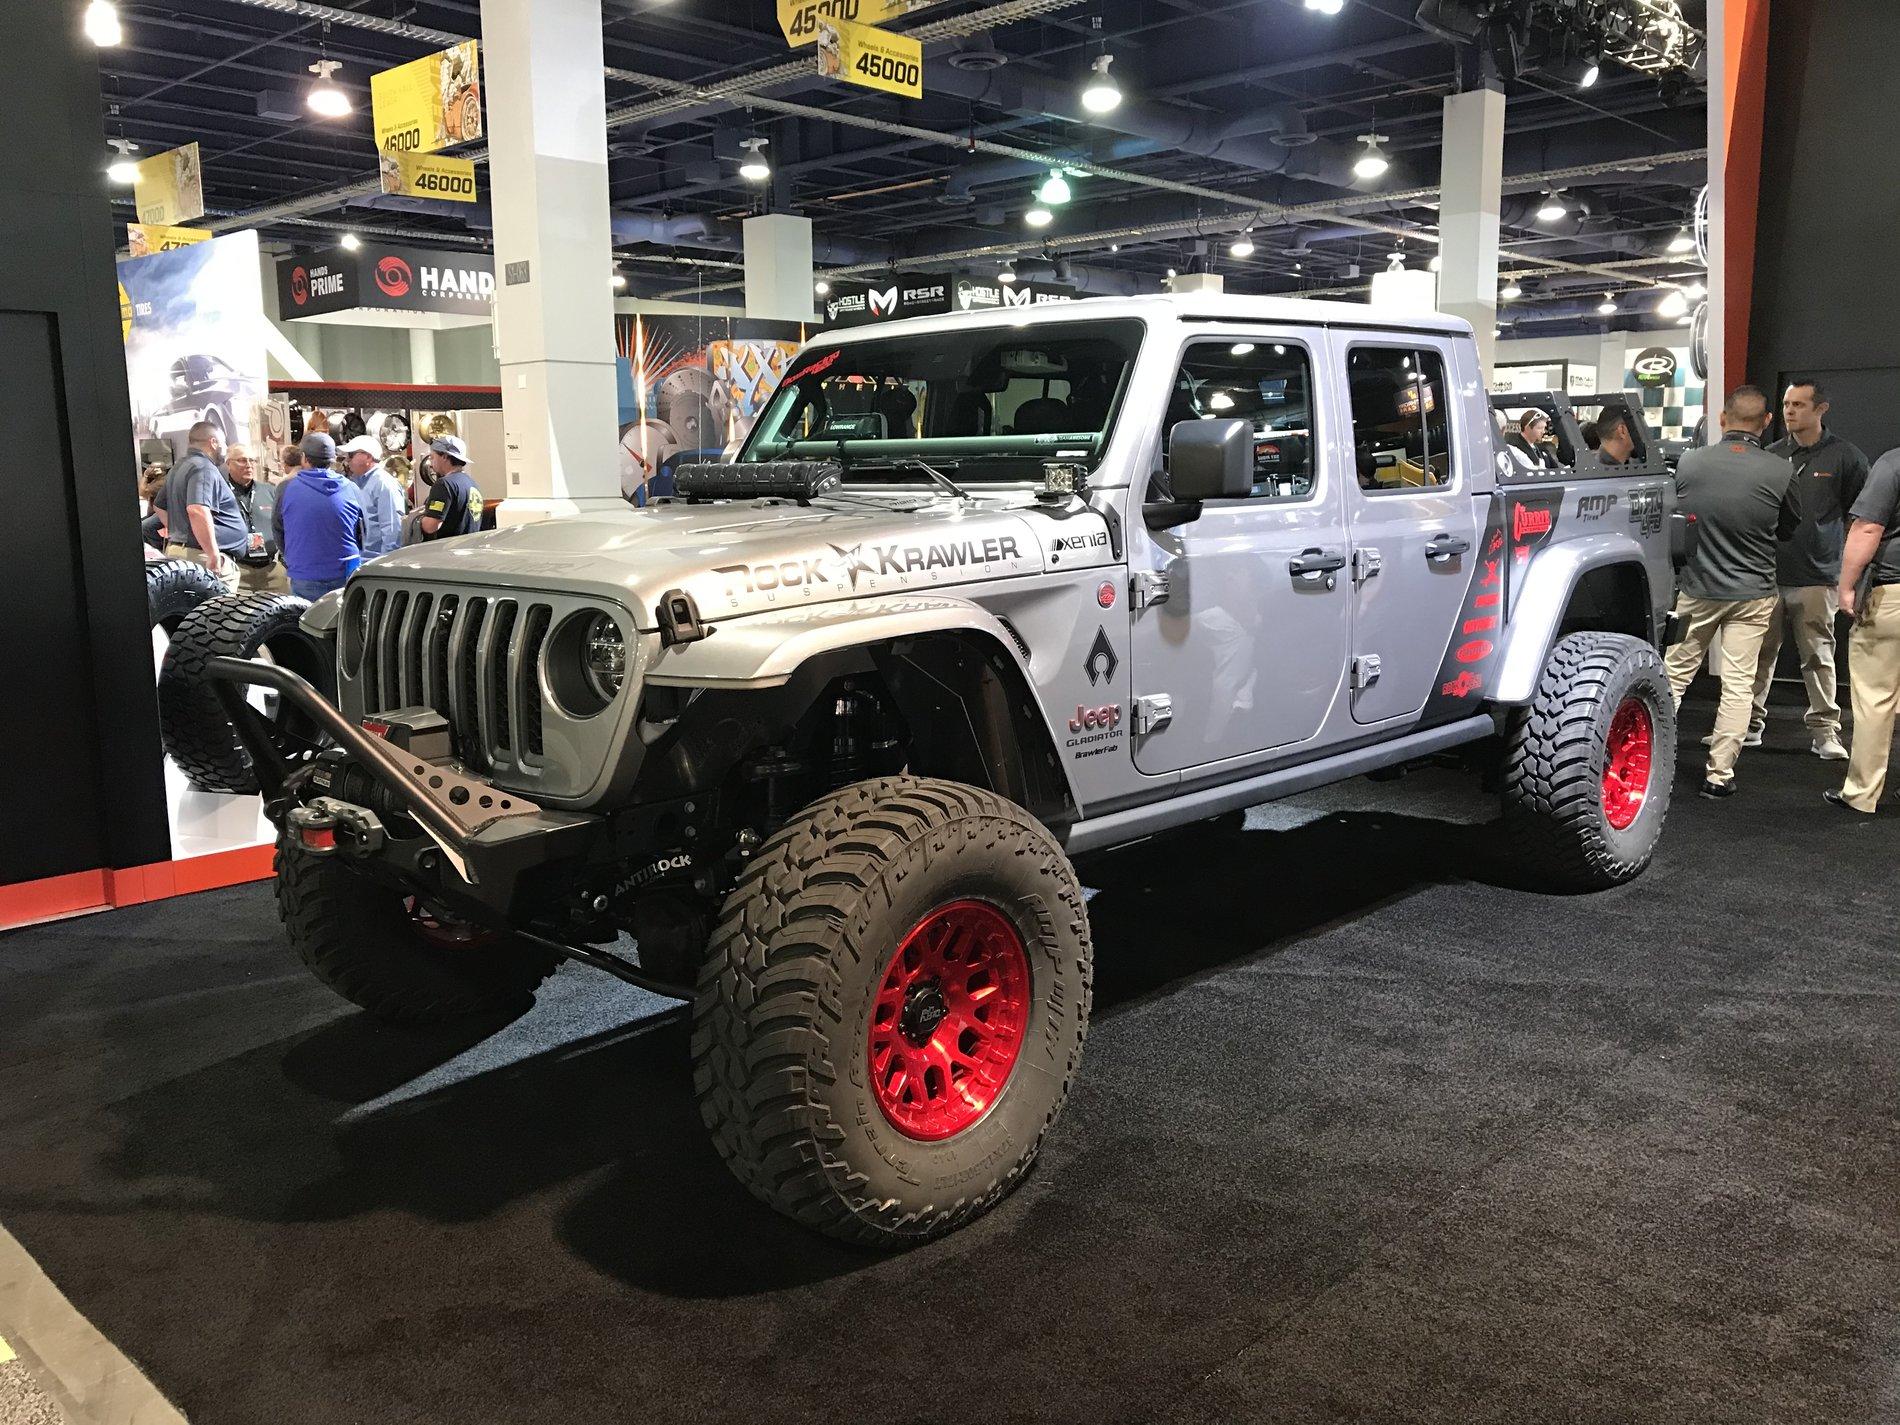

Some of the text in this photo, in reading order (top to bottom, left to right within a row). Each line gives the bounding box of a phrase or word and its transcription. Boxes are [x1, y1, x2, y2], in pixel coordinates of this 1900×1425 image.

[857, 40, 879, 53] Wheels
[885, 47, 919, 62] Accessories
[855, 52, 919, 87] 45000
[414, 173, 473, 194] 46000
[309, 265, 328, 277] HANDS
[310, 272, 344, 297] PRIME
[903, 285, 945, 301] RSR
[1576, 494, 1618, 520] AMP
[1063, 531, 1109, 549] xenia
[711, 535, 1024, 597] ROCK KRAWLER
[1068, 704, 1122, 735] Jeep
[1066, 729, 1123, 748] GLADIATOR
[1075, 744, 1118, 760] BrawlerFab
